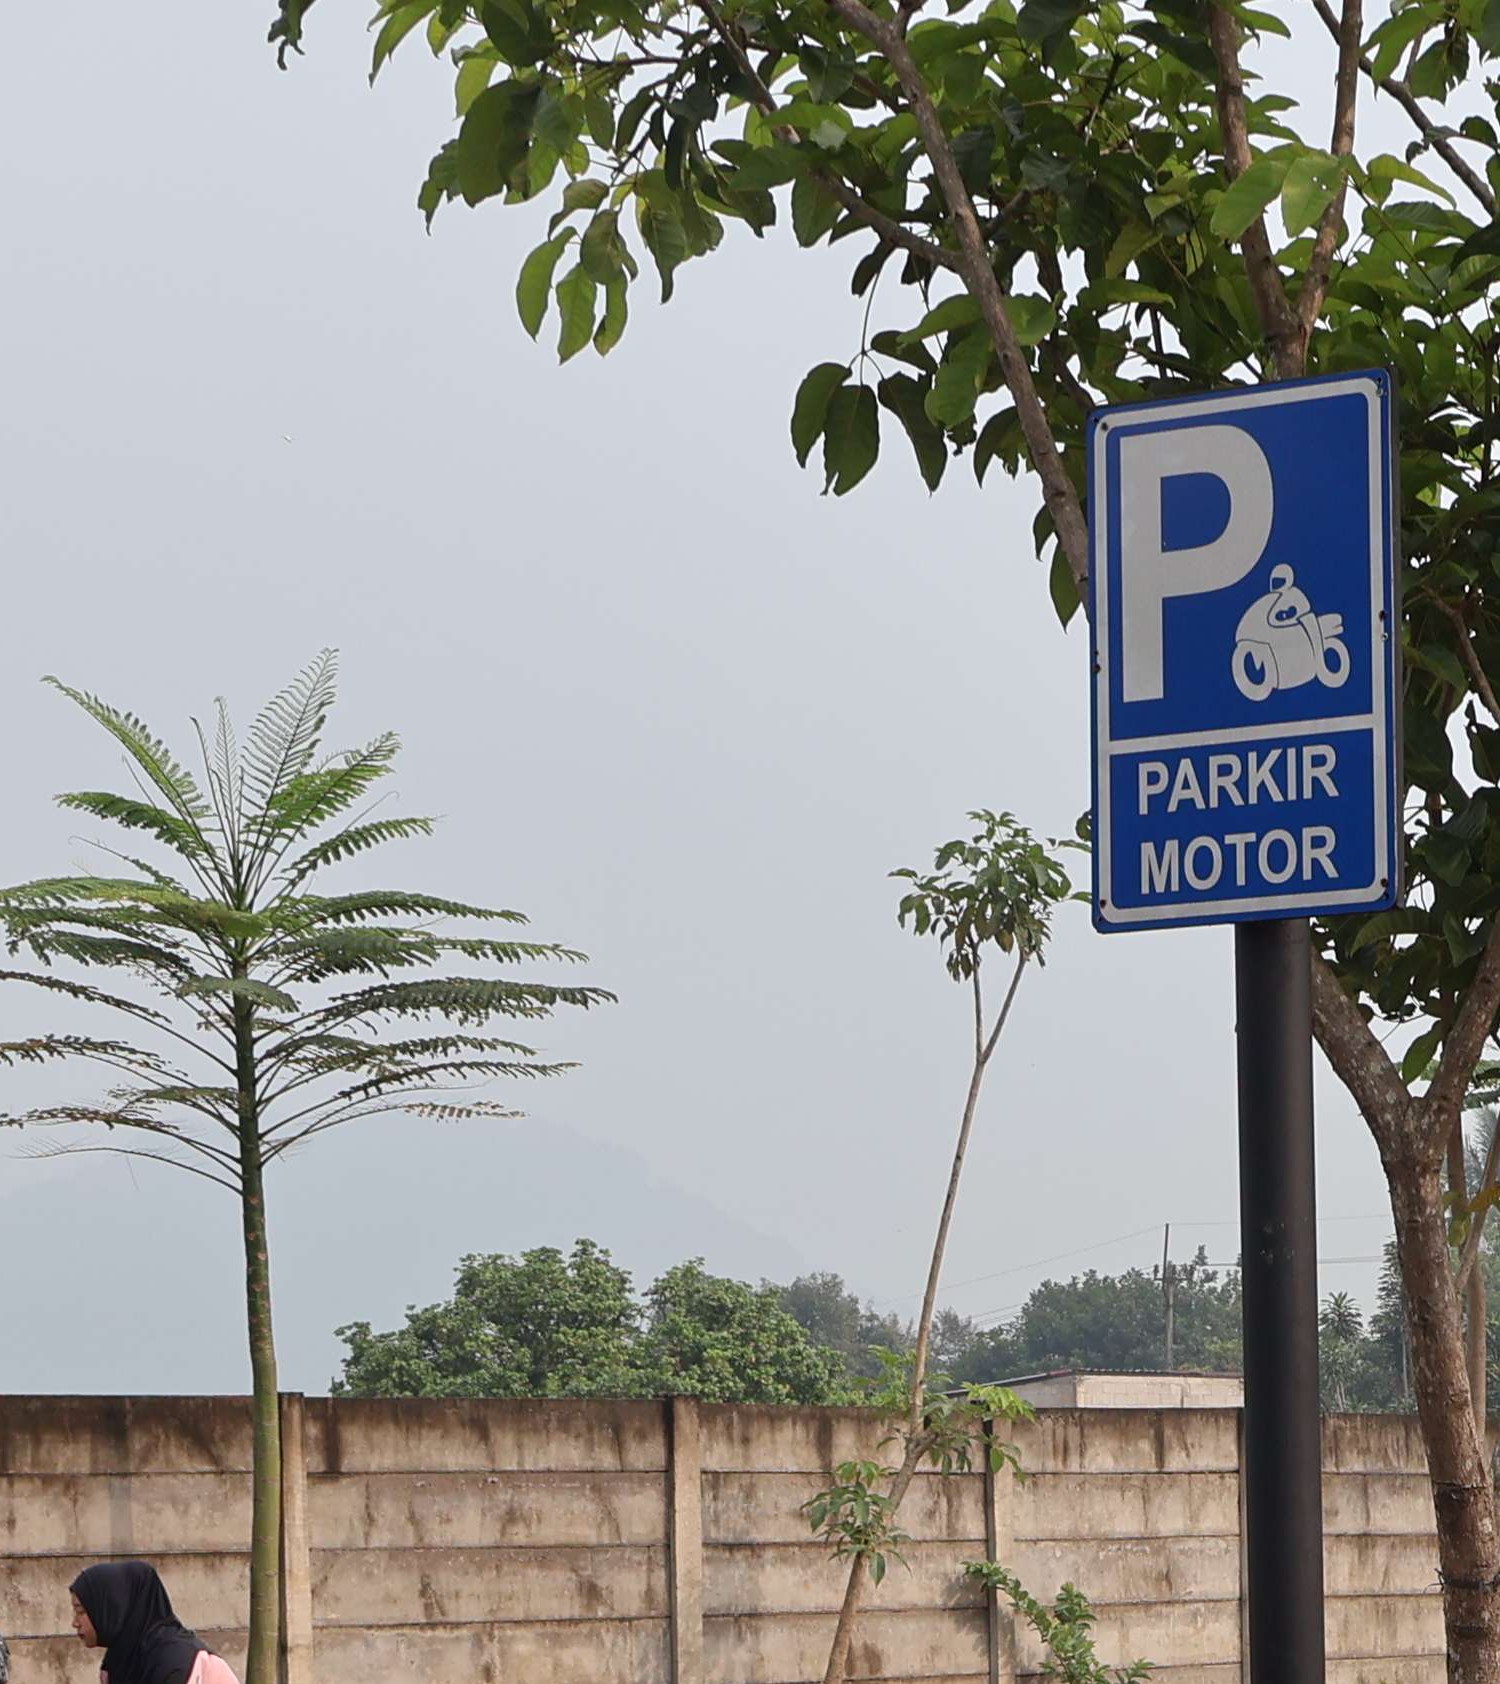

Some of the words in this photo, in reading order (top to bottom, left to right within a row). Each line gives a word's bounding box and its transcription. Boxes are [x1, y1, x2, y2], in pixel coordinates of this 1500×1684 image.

[1120, 424, 1274, 703] P
[1138, 743, 1340, 816] PARKIR
[1140, 825, 1340, 895] MOTOR
